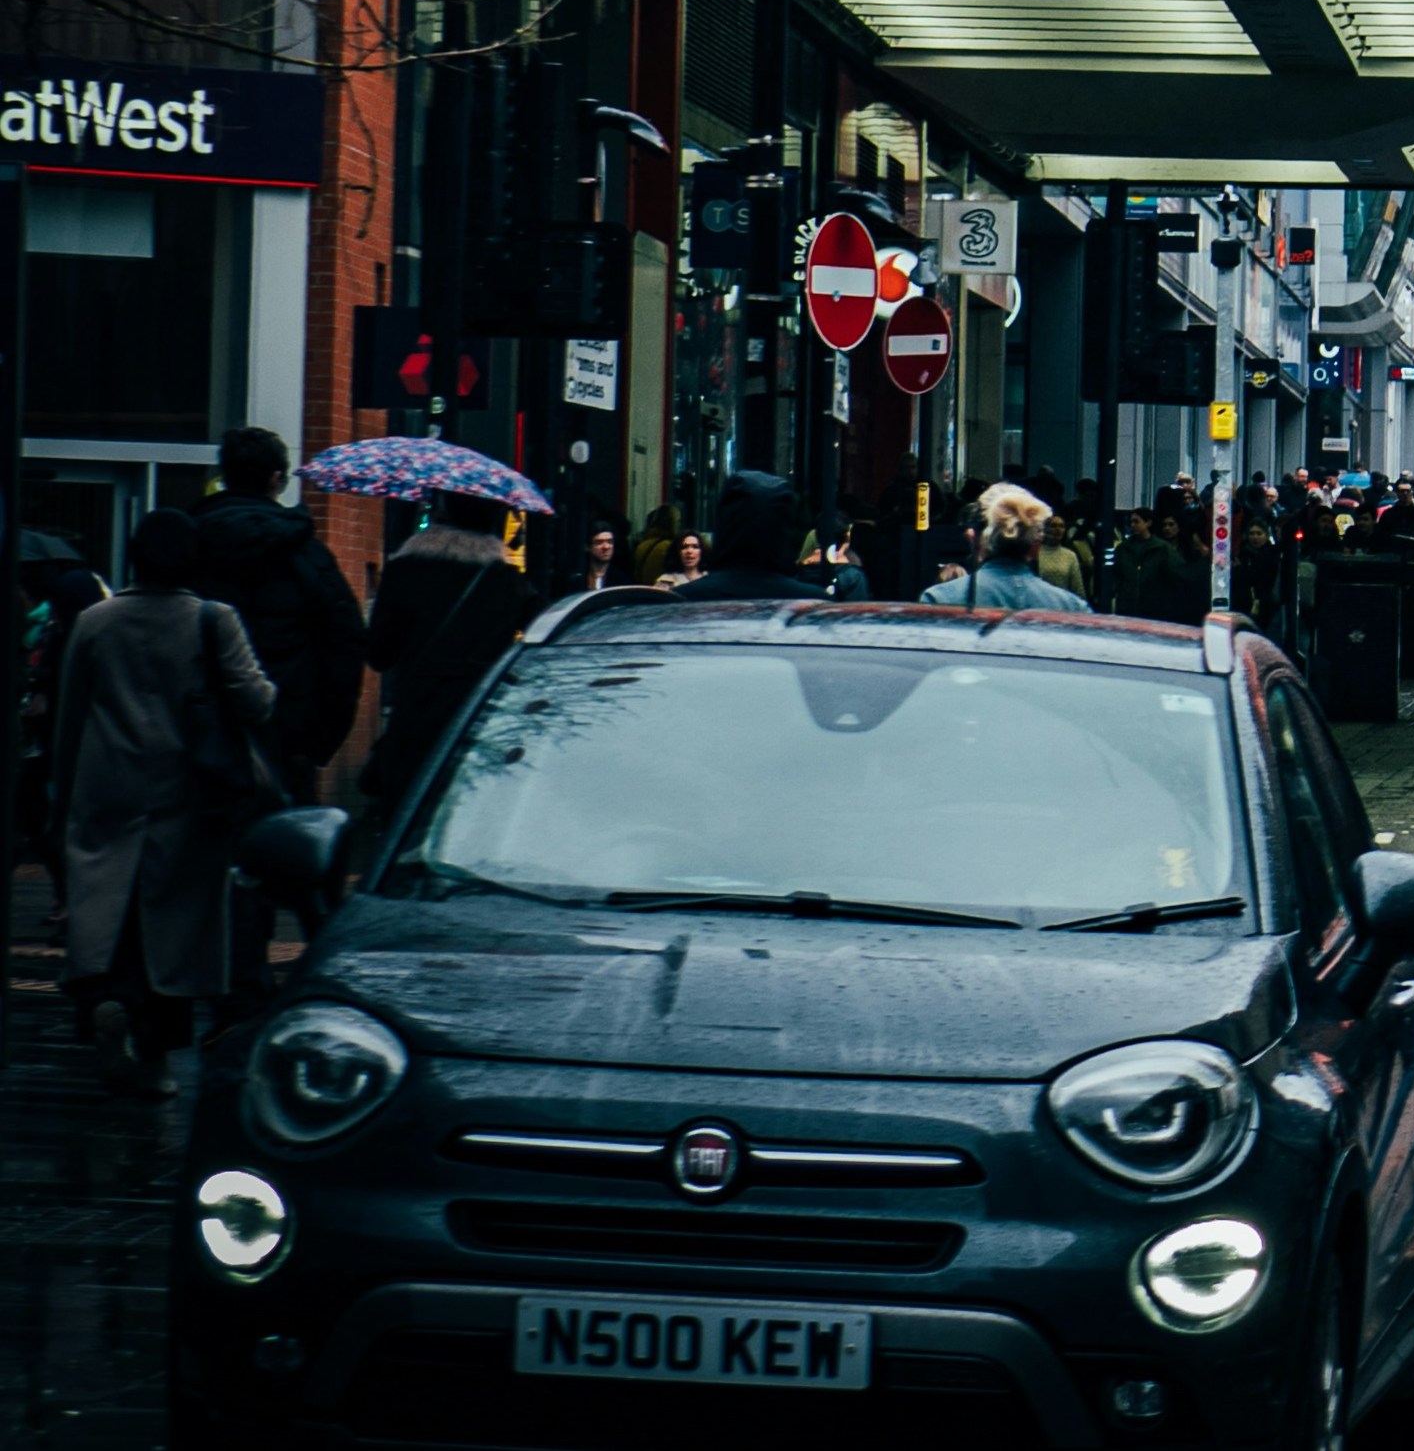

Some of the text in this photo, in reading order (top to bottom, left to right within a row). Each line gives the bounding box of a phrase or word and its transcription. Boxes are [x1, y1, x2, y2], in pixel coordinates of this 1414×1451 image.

[713, 207, 750, 225] TS
[960, 209, 998, 258] 3
[688, 1147, 727, 1176] FIAT
[542, 1307, 843, 1378] N500 KEW
